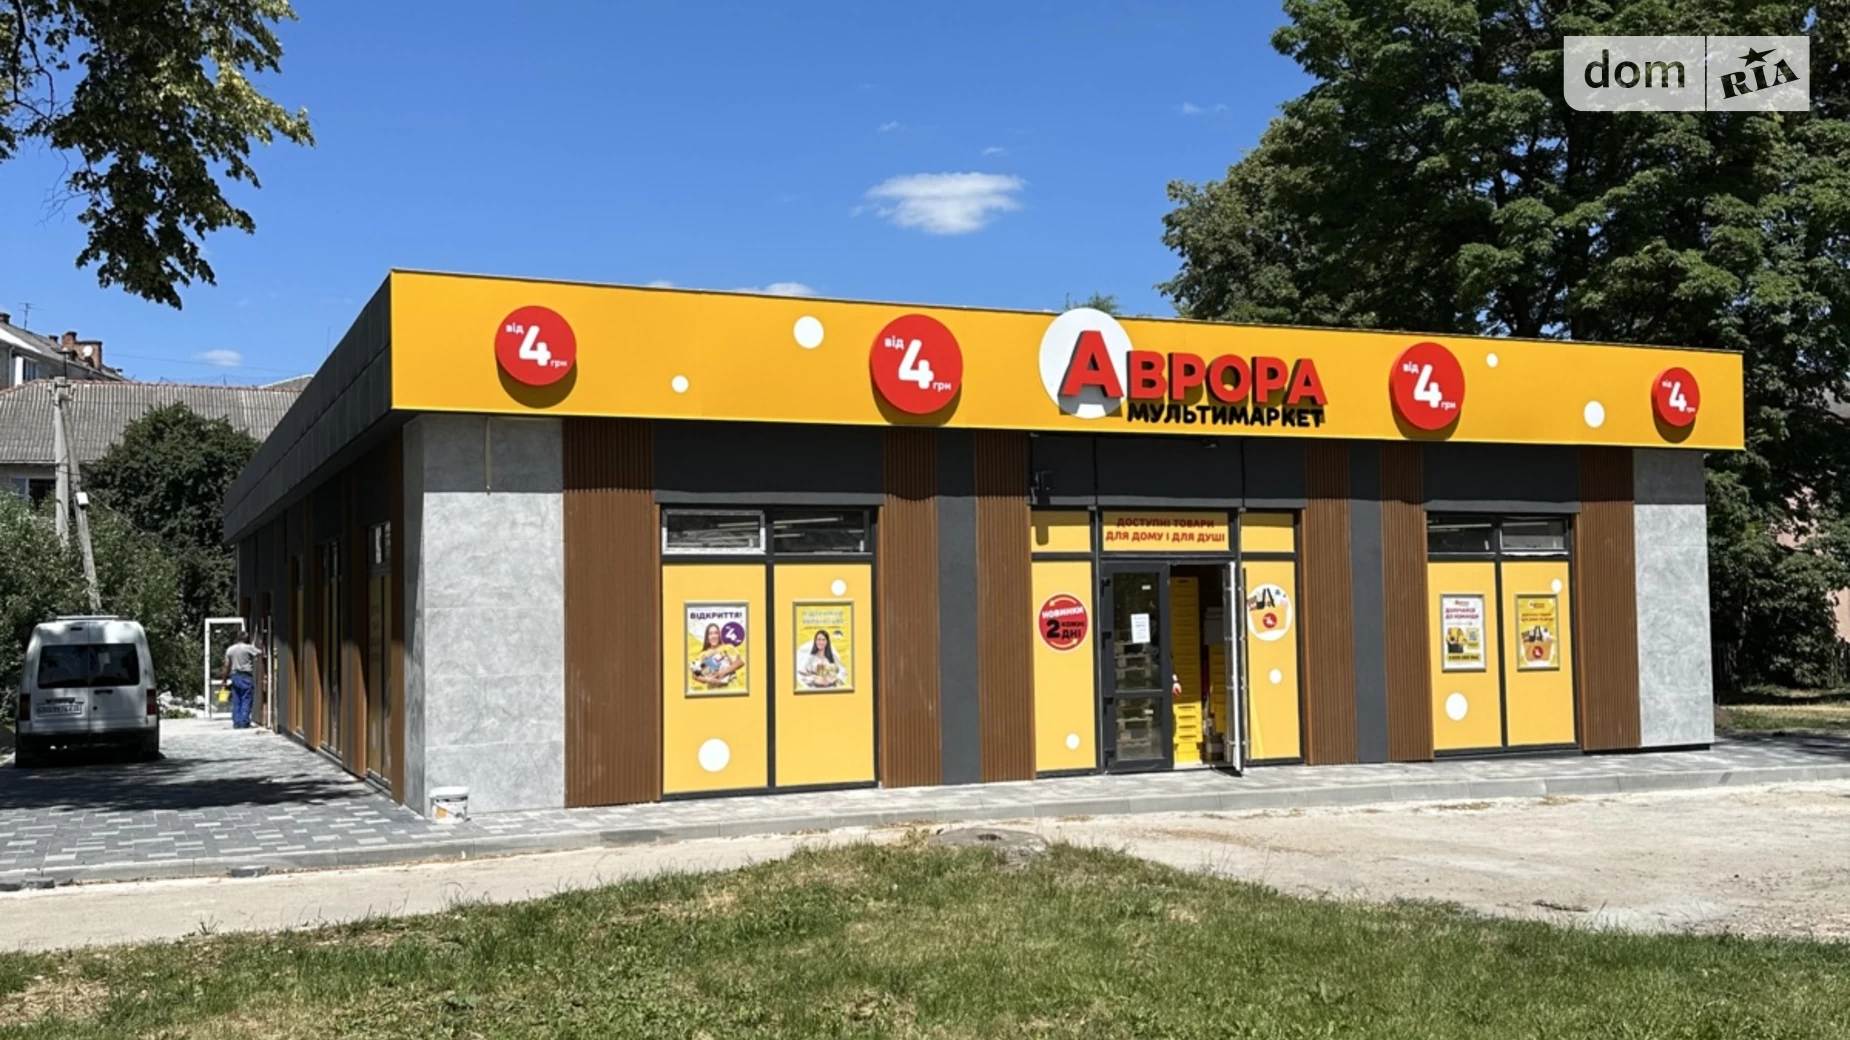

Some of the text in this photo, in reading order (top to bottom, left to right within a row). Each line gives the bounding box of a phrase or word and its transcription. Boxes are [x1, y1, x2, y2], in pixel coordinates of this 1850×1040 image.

[505, 322, 524, 334] від
[519, 325, 551, 366] 4
[884, 335, 904, 350] від
[898, 338, 934, 389] 4
[1058, 330, 1328, 405] АВРОРА
[1403, 361, 1419, 374] від
[932, 382, 952, 392] грн
[1414, 363, 1443, 408] 4
[1669, 381, 1687, 412] 4
[1127, 403, 1324, 427] МУЛЬТИМАРКЕТ
[1116, 517, 1214, 528] ДОСТУПНІ ТОВАРИ
[1106, 531, 1129, 541] ДЛЯ
[1131, 532, 1163, 542] ДОМУ
[1172, 532, 1194, 542] ДЛЯ
[1197, 533, 1225, 543] ДУШІ
[690, 612, 742, 620] ВІДКРИТТЯ!
[1042, 606, 1084, 619] НОВИНКИ
[725, 628, 738, 640] 4
[1047, 619, 1060, 638] 2
[1062, 629, 1081, 640] ДНІ
